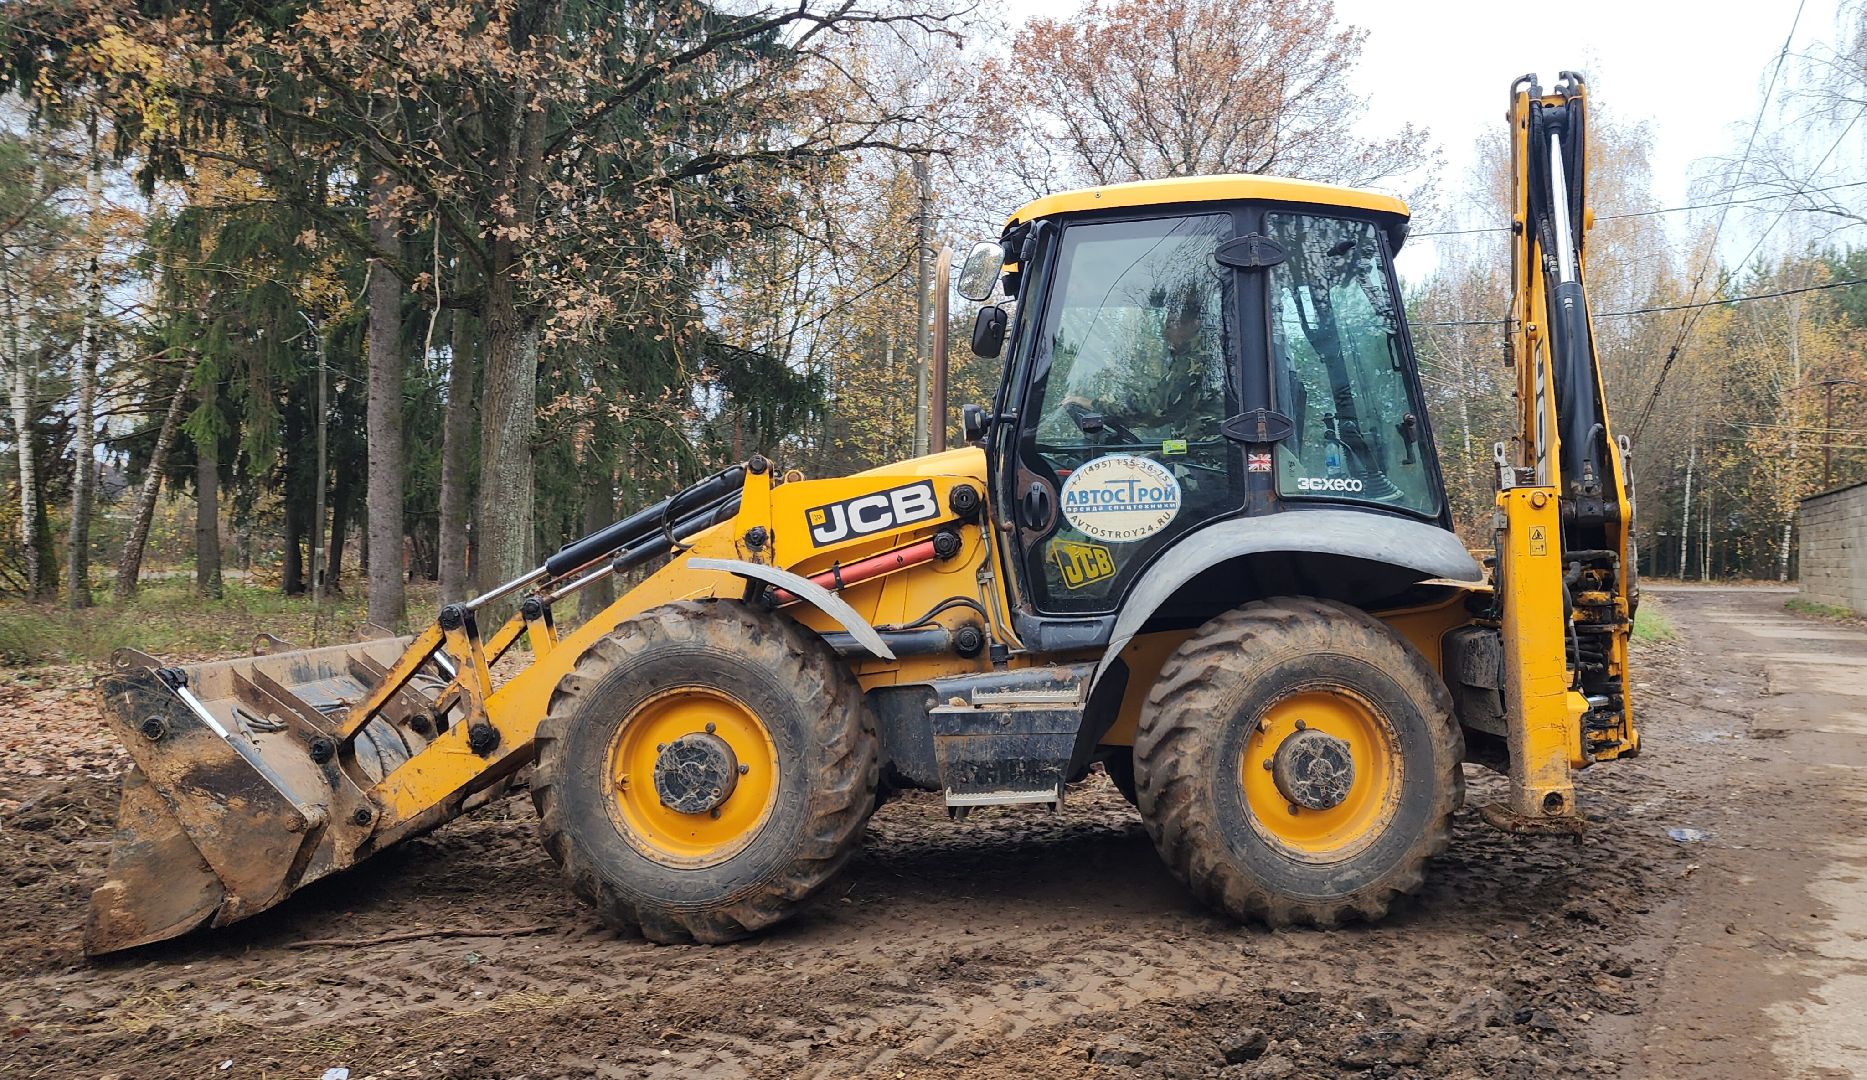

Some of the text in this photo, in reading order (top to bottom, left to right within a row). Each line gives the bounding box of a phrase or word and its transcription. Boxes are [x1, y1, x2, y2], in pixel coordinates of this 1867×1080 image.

[1084, 461, 1111, 476] (495)
[813, 484, 936, 543] JCB
[1066, 503, 1177, 513] аренда спецтехники
[1070, 511, 1171, 539] AVTOSTROY24.RU
[1062, 545, 1112, 585] JCB
